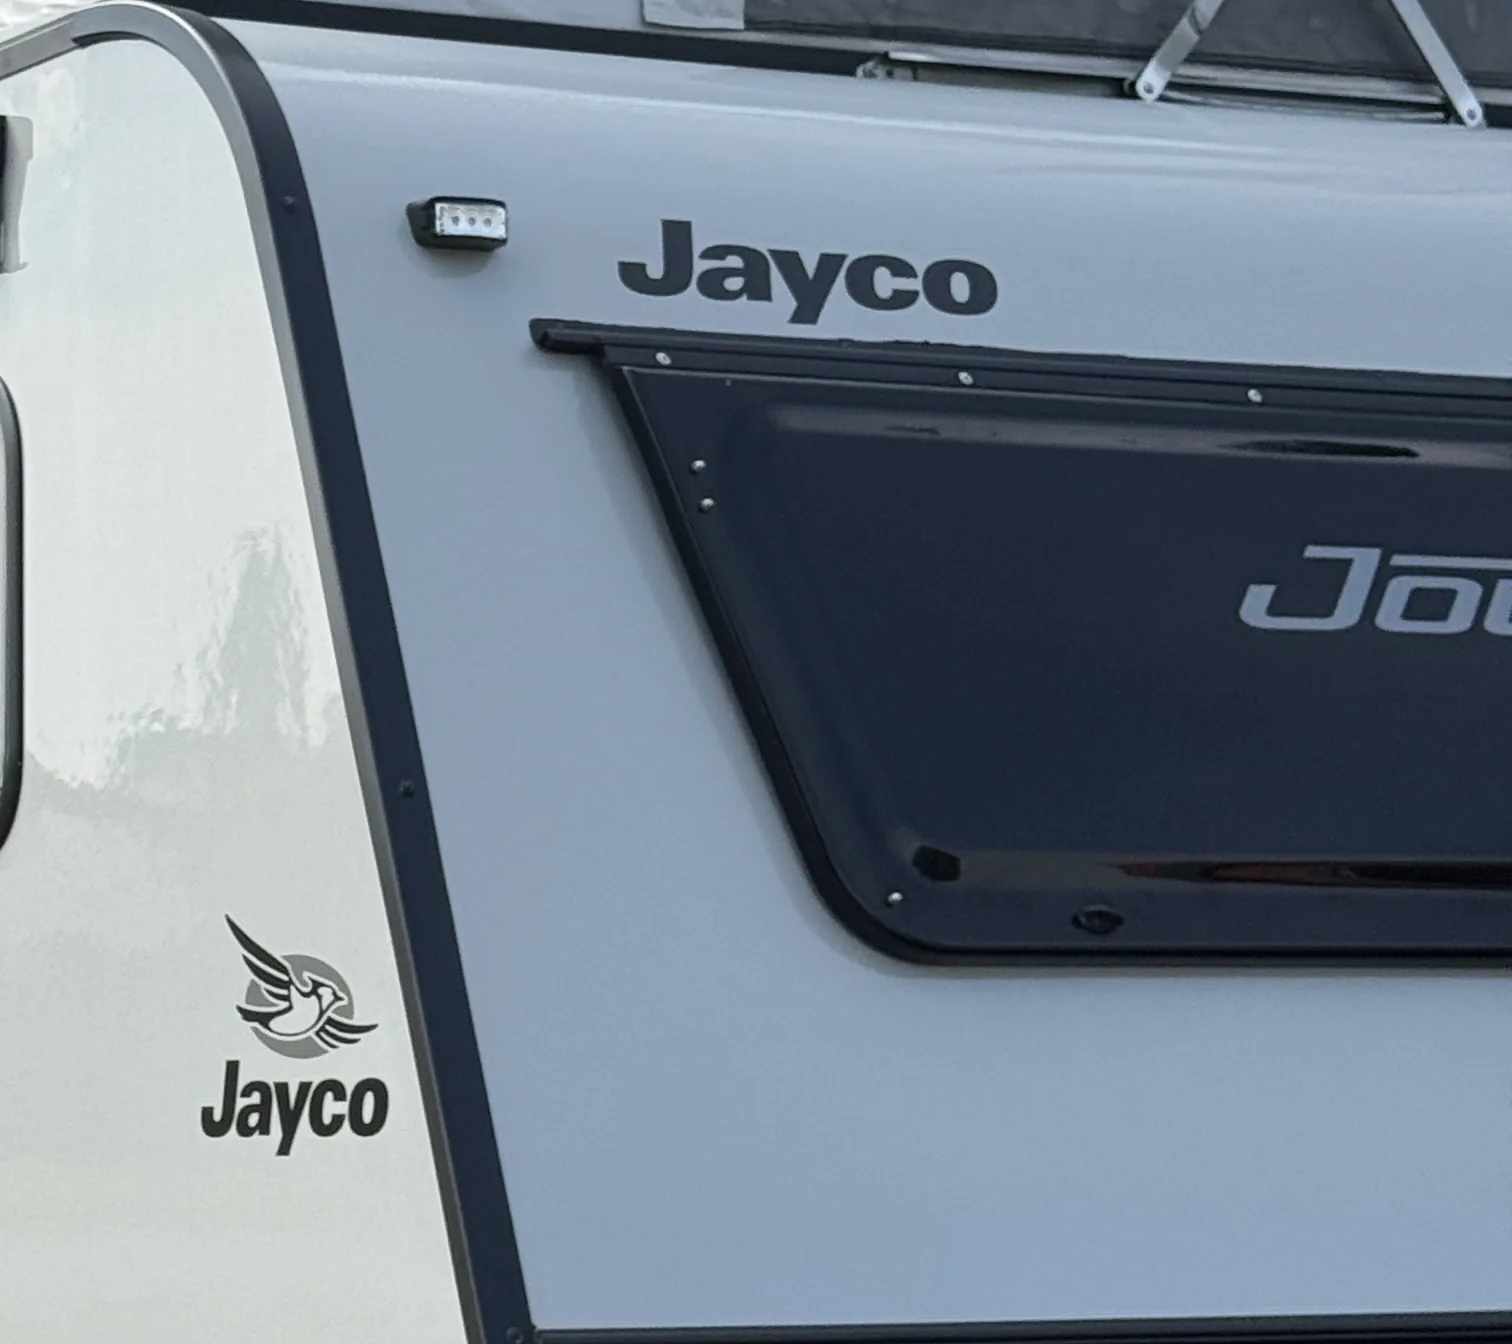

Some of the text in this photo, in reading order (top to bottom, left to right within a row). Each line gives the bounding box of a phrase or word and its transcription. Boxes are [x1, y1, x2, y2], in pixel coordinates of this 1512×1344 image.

[618, 219, 998, 325] Jayco
[1239, 544, 1512, 636] Jo
[201, 1060, 389, 1156] Jayco
